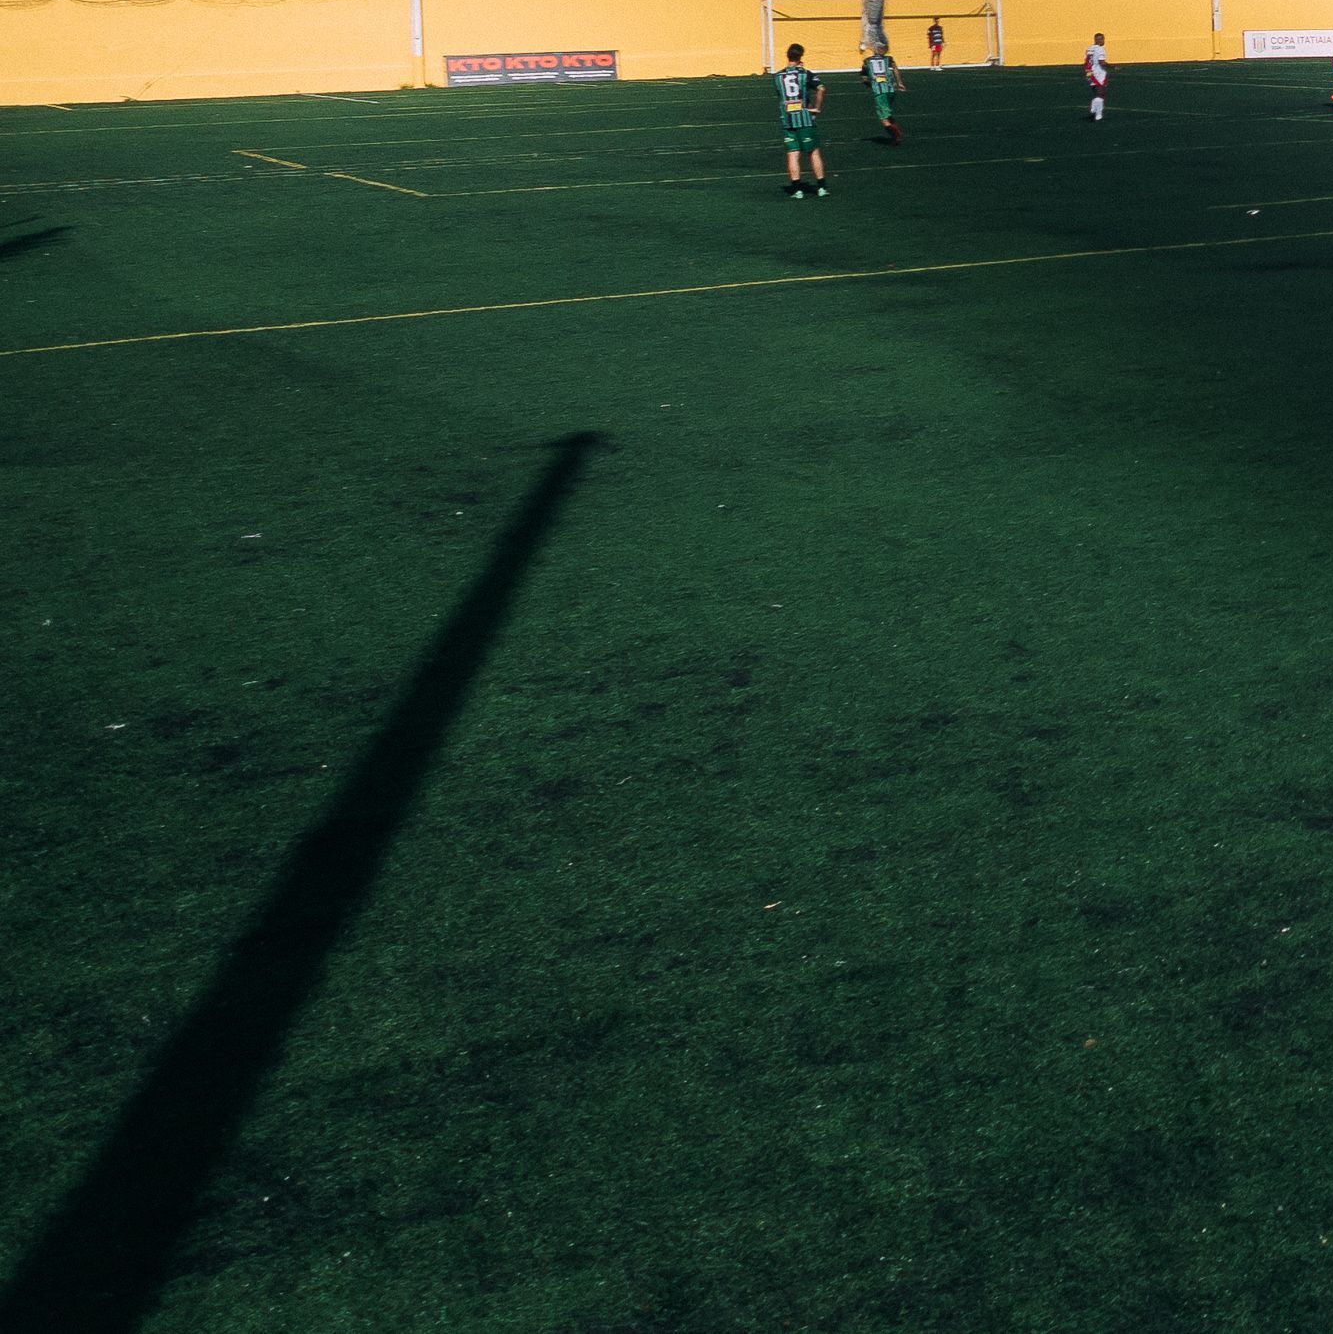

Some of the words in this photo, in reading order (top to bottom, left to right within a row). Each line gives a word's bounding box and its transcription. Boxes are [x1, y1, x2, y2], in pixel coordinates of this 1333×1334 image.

[1270, 36, 1295, 45] COPA
[447, 56, 502, 72] KTO
[504, 55, 558, 70] KTO
[561, 53, 615, 67] KTO
[783, 74, 800, 97] 6
